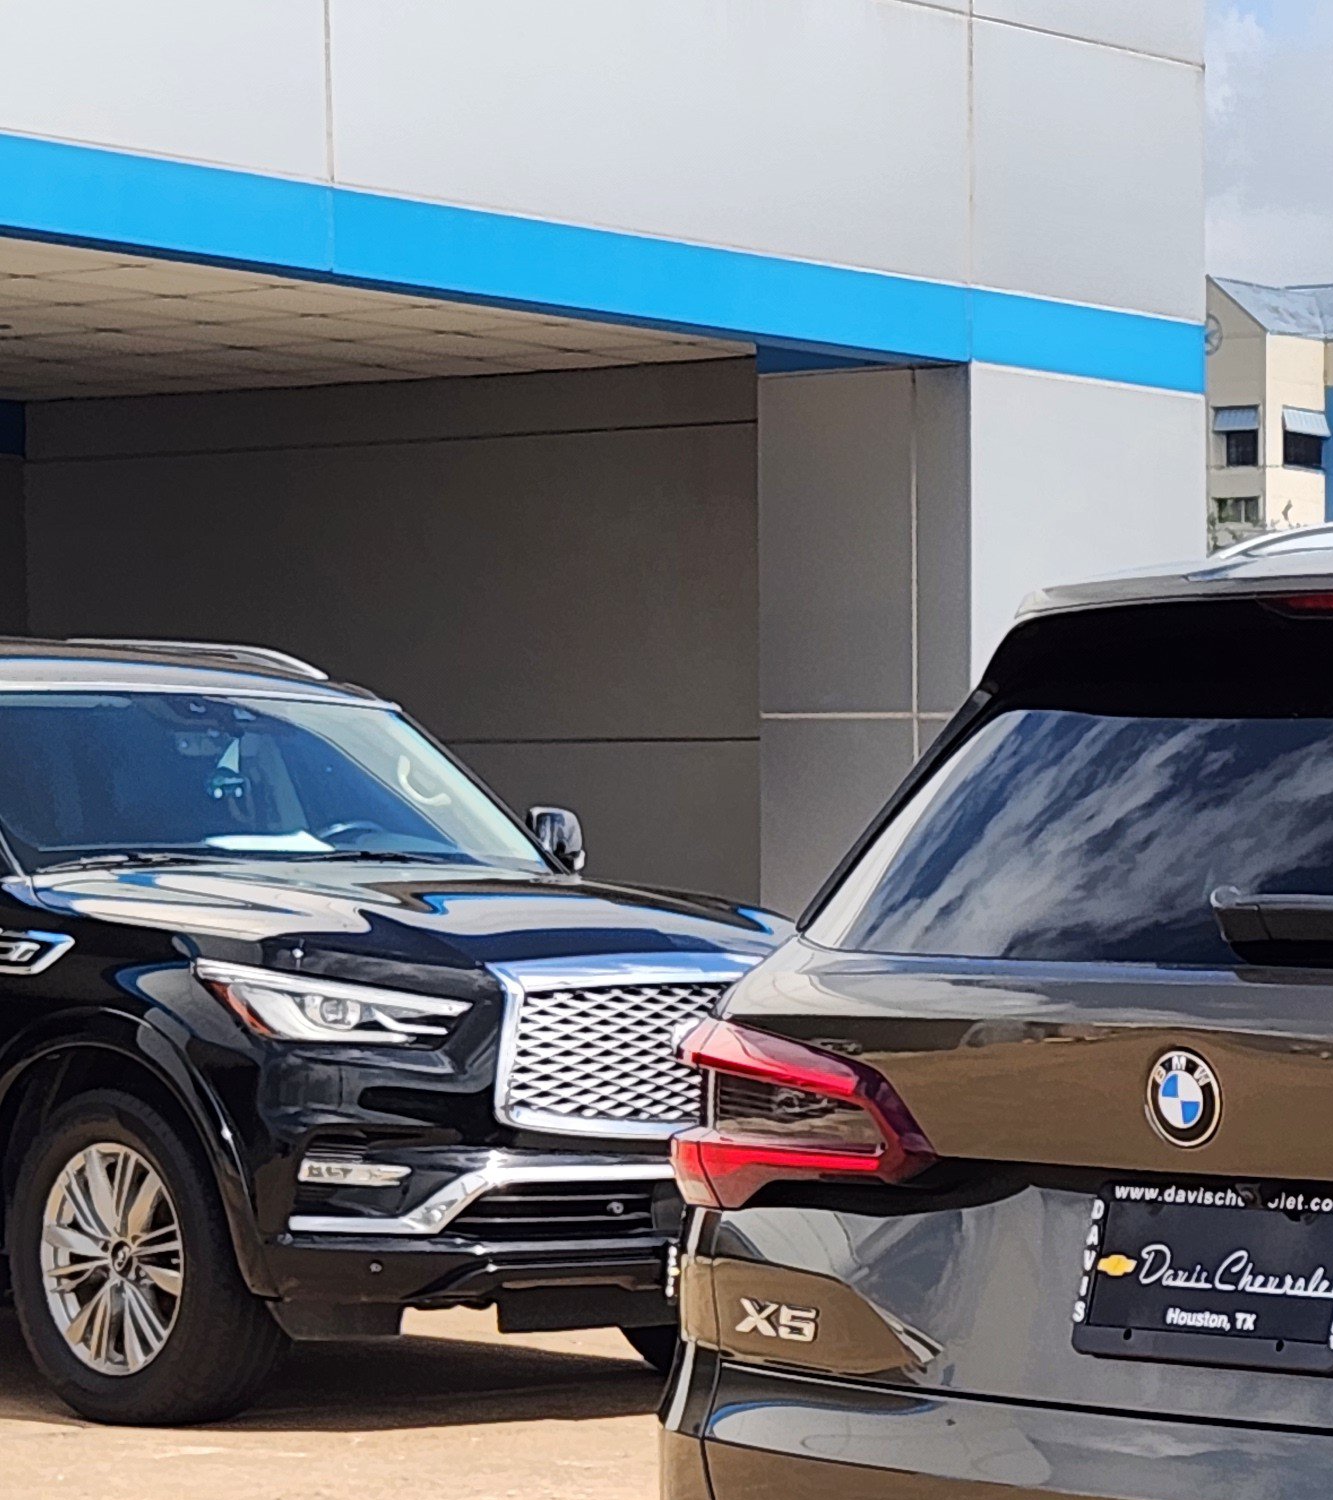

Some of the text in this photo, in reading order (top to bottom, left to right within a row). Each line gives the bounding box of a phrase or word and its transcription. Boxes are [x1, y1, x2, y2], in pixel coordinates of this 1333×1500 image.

[1072, 1199, 1105, 1322] DAVIS
[1138, 1244, 1212, 1289] Davis
[735, 1297, 818, 1342] X5
[1165, 1307, 1257, 1332] Houston, TX
